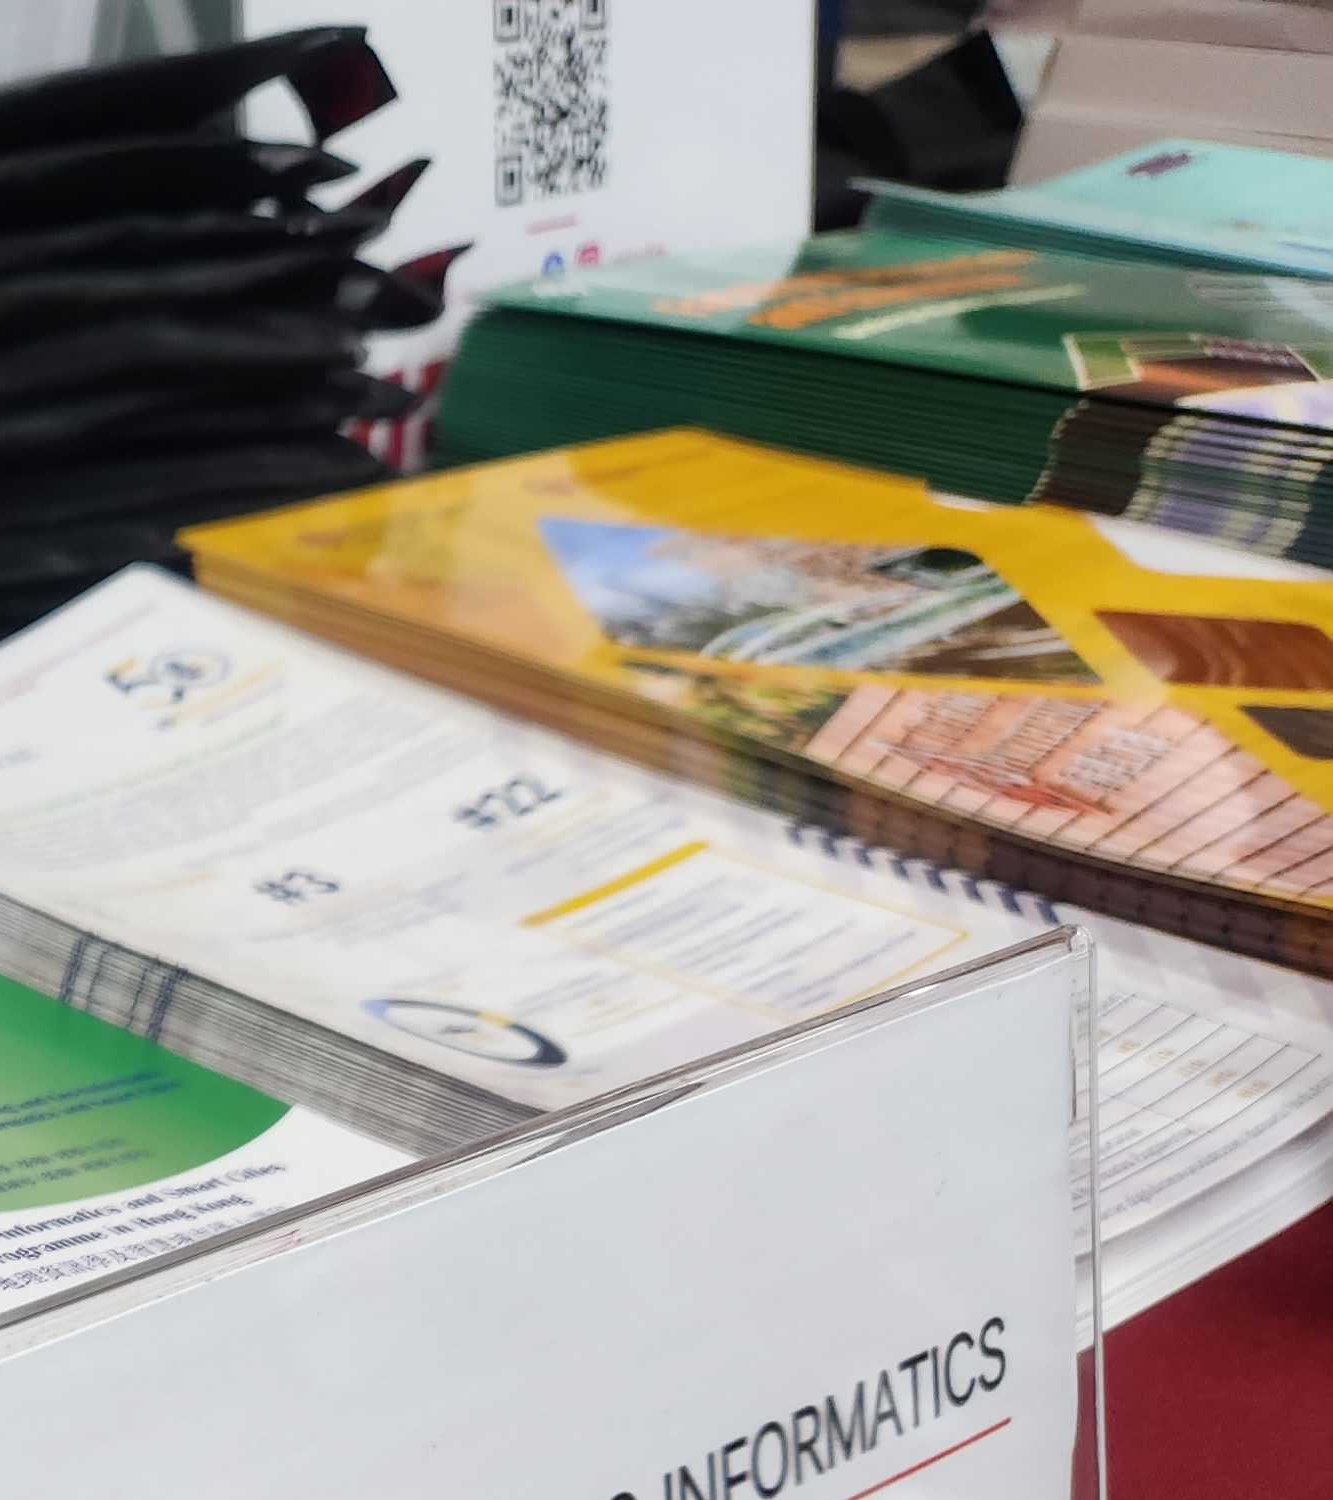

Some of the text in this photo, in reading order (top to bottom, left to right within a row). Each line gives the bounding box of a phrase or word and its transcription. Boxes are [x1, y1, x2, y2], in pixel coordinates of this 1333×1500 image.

[124, 1193, 164, 1211] and
[161, 1176, 228, 1200] Smart
[109, 1220, 131, 1236] in
[131, 1206, 198, 1232] Hong
[188, 1194, 253, 1215] Kong
